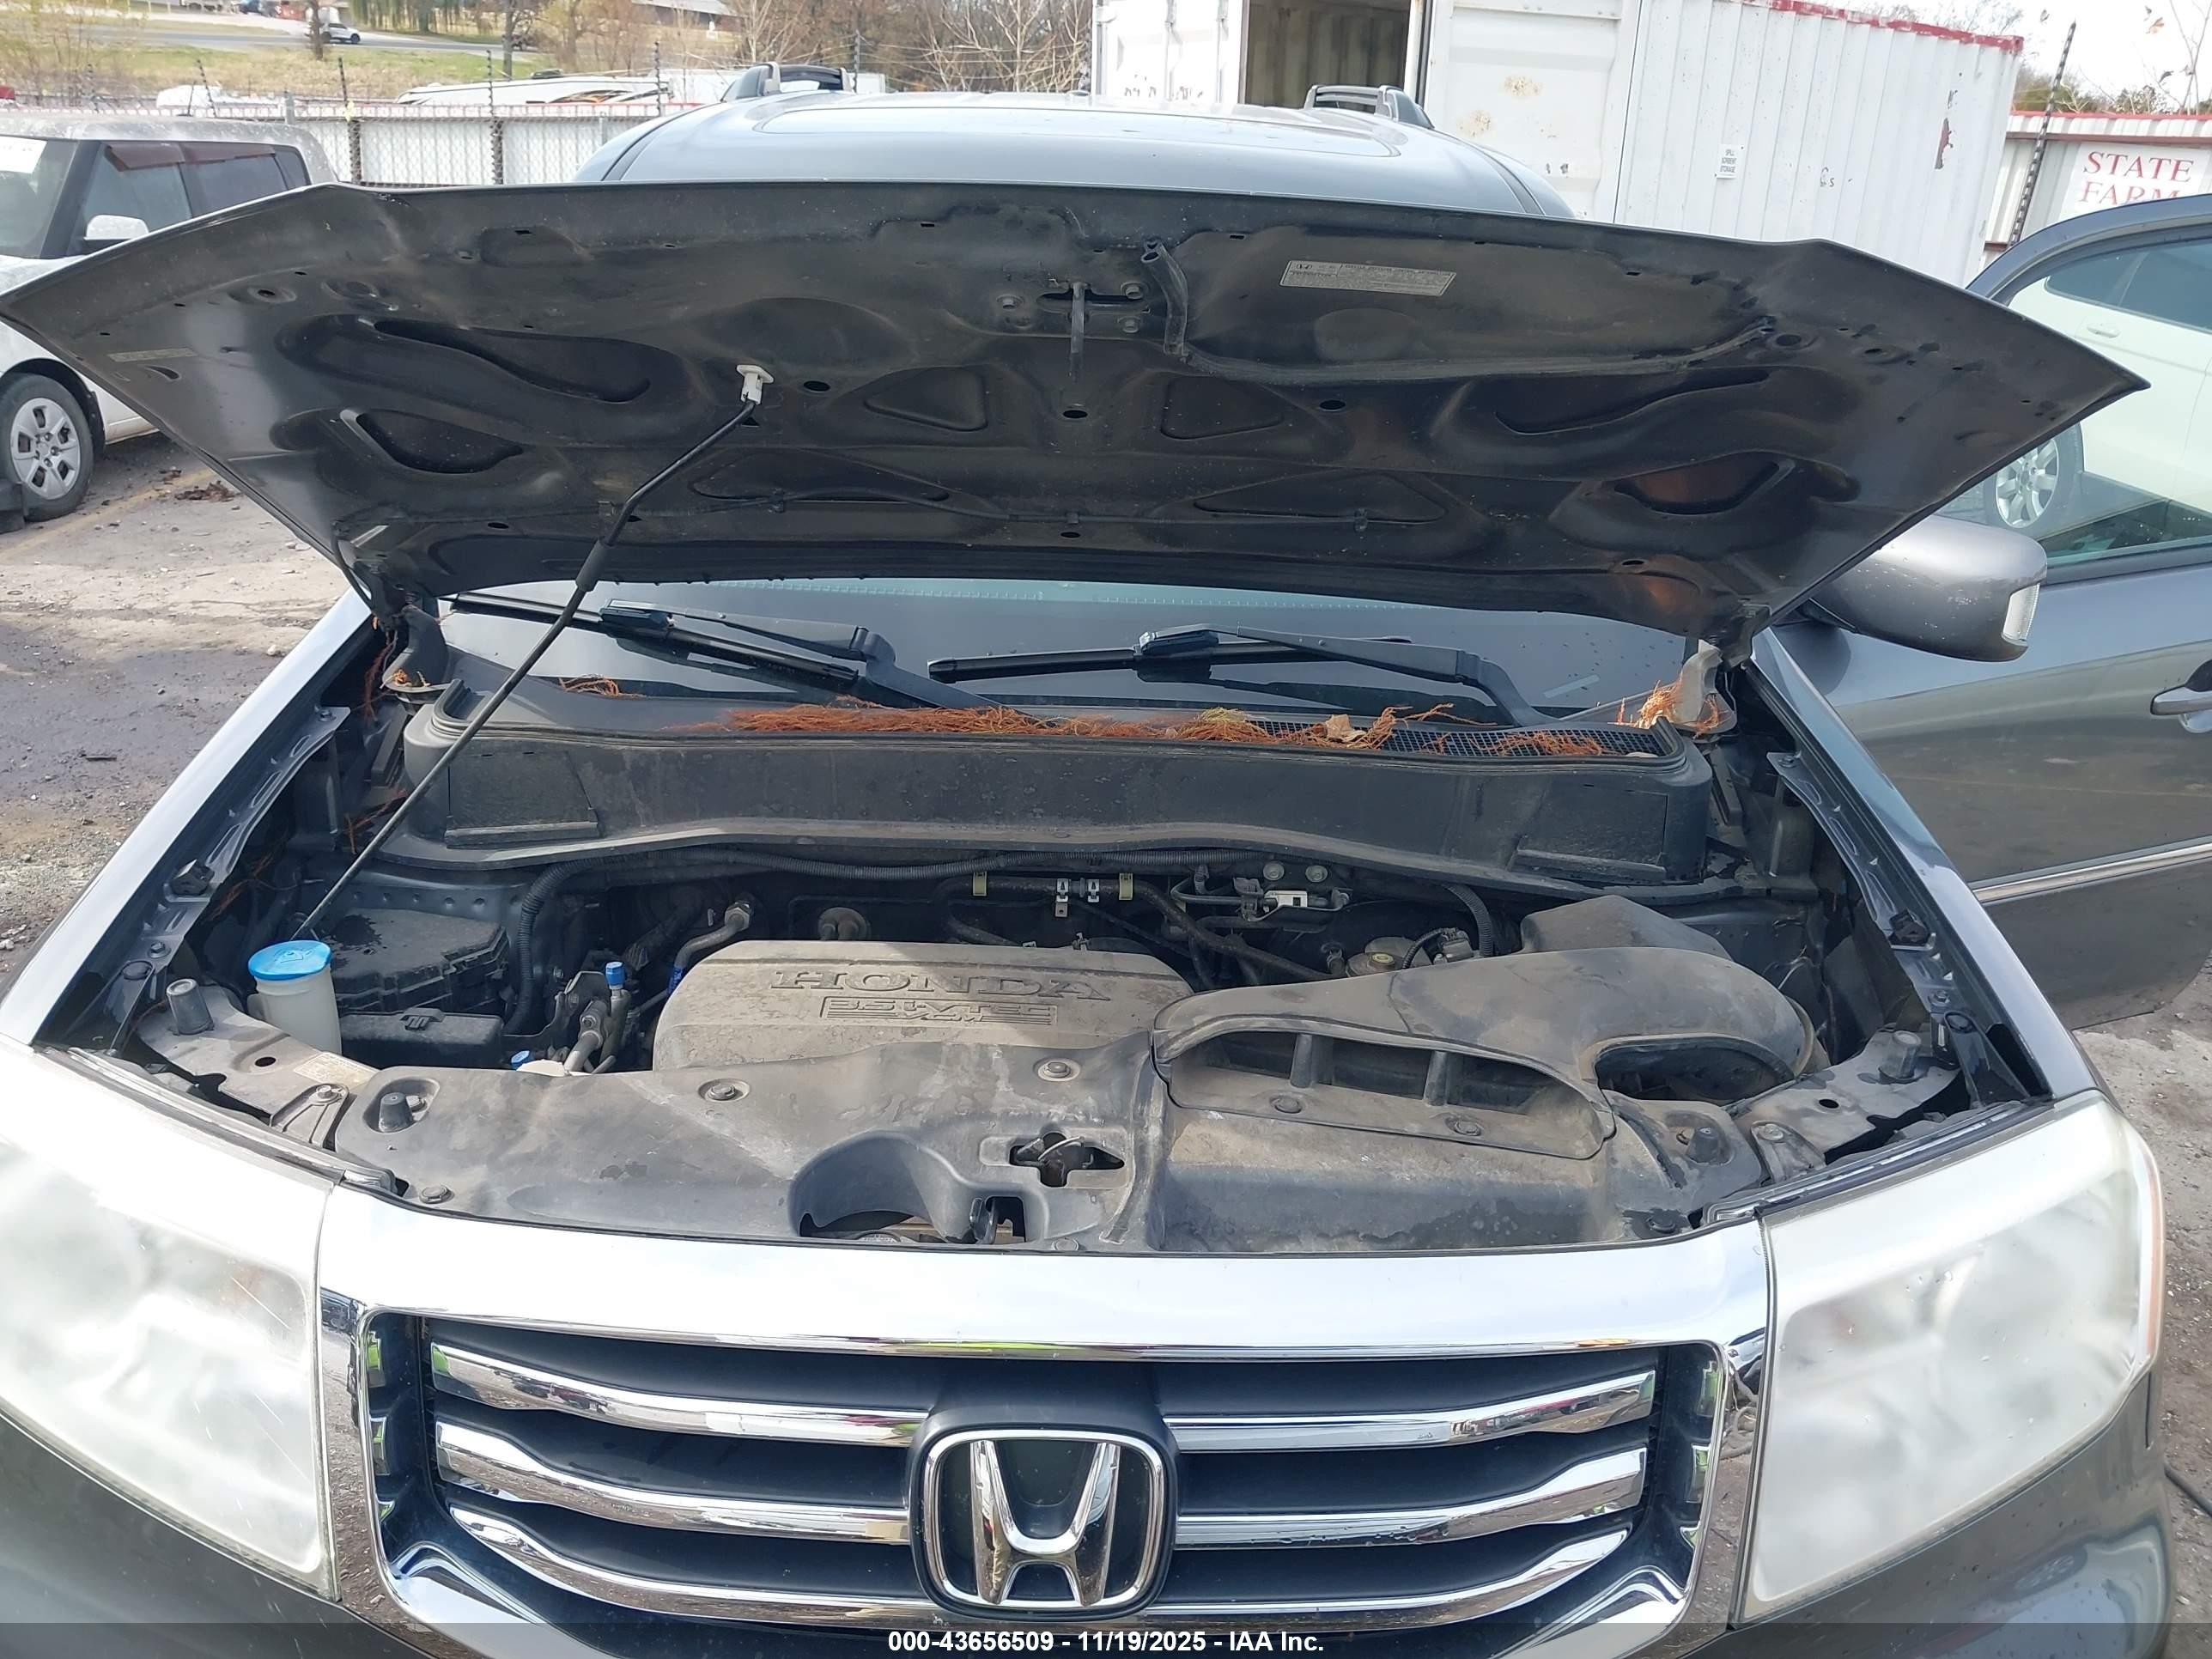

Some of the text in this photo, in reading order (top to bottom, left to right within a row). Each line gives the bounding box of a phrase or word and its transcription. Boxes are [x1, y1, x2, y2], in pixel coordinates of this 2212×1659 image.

[2083, 150, 2195, 183] STATE
[770, 970, 1111, 1001] HONDA
[828, 1000, 896, 1012] 3.5
